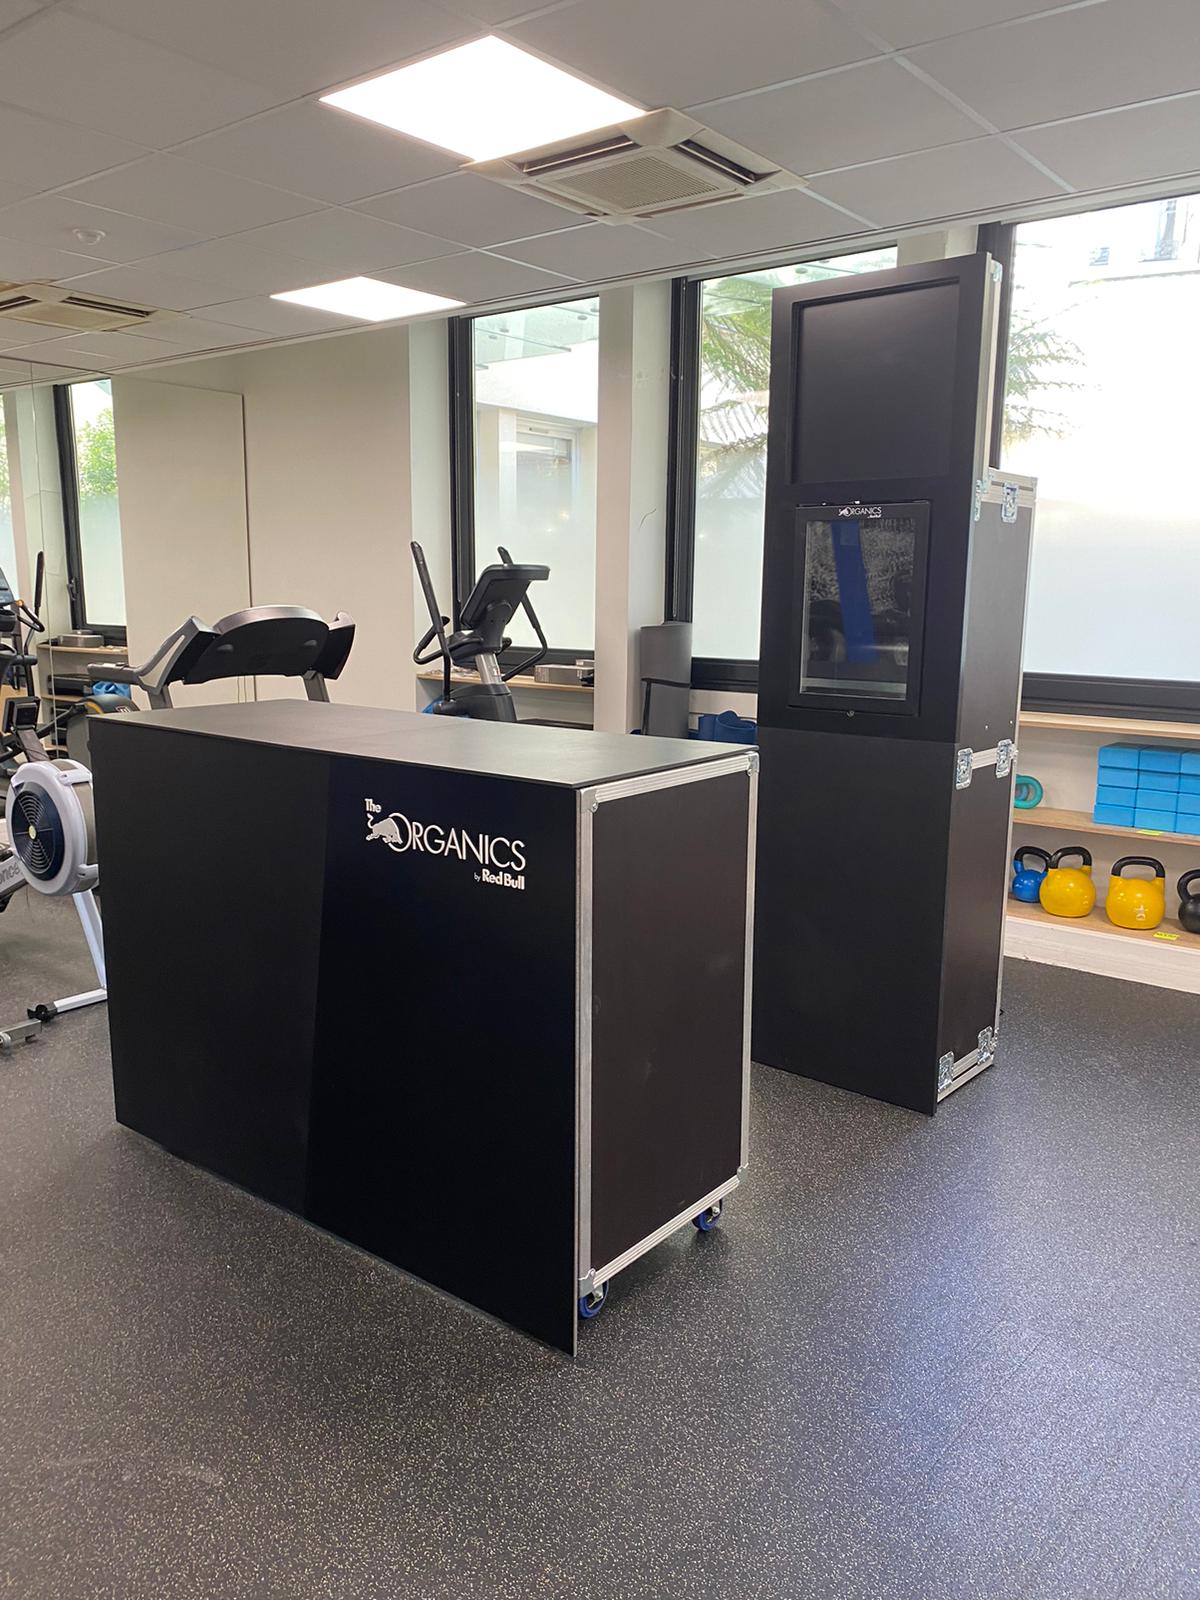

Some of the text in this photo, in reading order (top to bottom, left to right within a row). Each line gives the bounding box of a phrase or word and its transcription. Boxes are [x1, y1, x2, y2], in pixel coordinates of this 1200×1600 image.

[364, 798, 382, 813] The
[388, 812, 526, 871] ORGANICS
[473, 871, 481, 882] by
